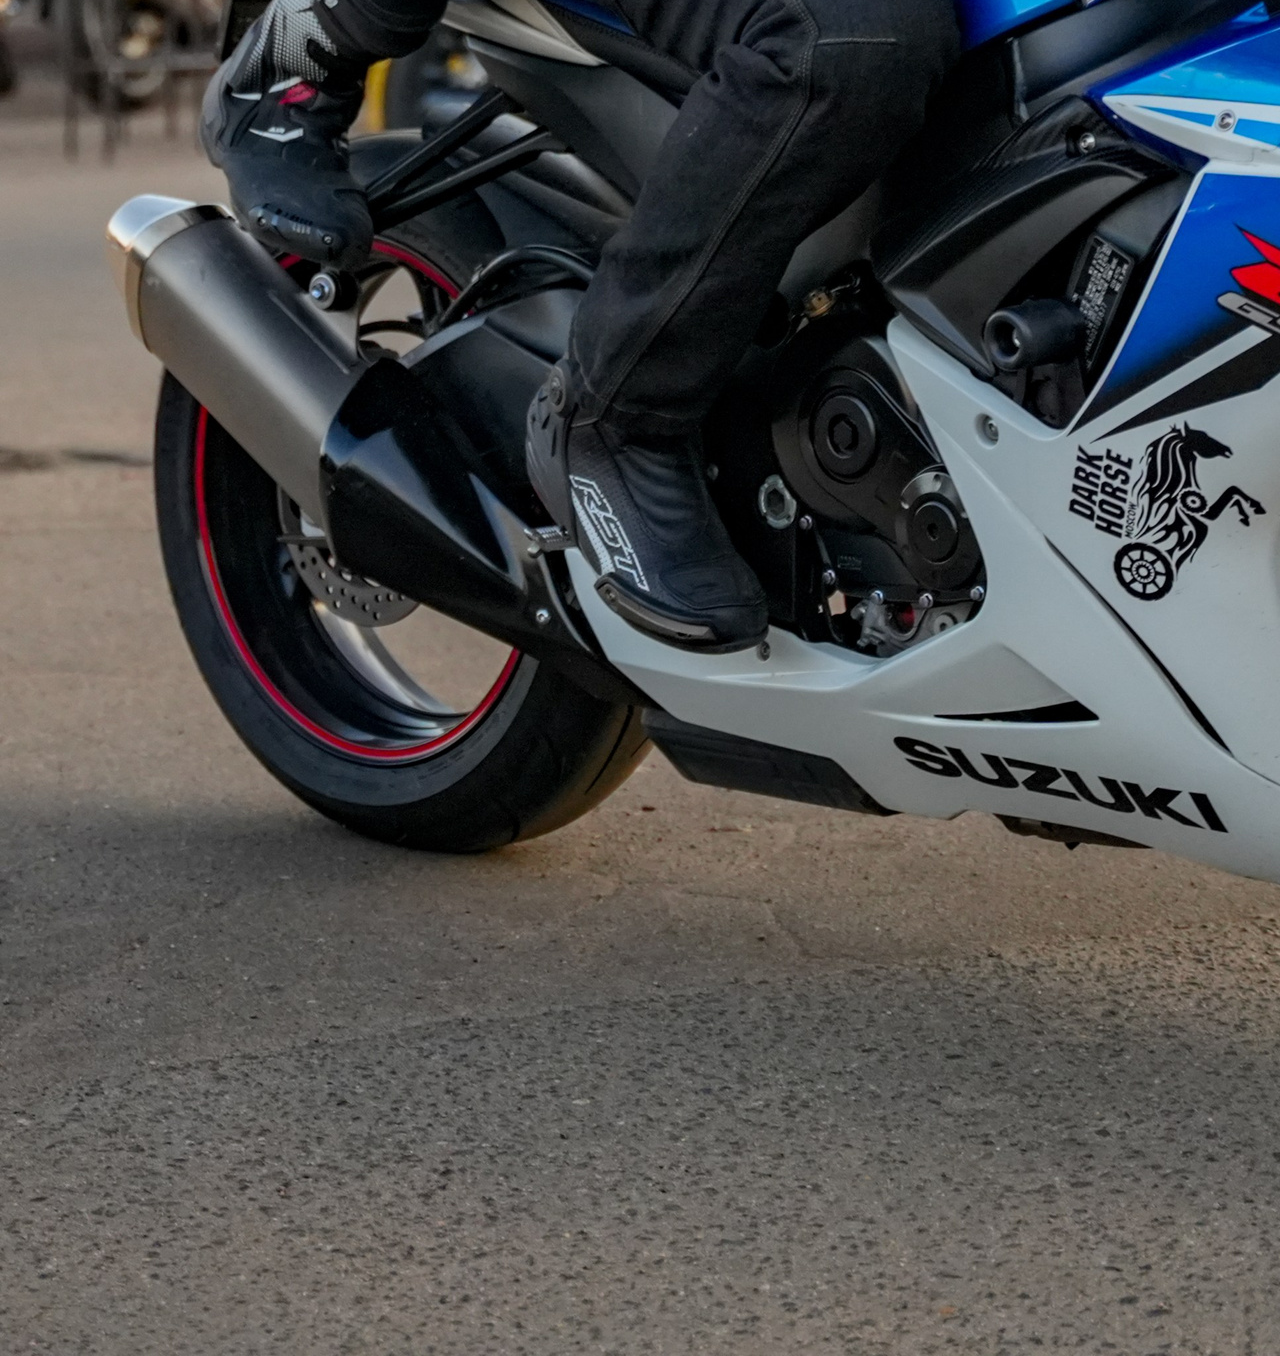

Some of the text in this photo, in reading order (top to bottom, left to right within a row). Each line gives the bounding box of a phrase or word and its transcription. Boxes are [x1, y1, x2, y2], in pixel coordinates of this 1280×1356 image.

[1068, 444, 1104, 522] DARK
[1095, 448, 1133, 539] HORSE
[1124, 501, 1138, 539] MOSCOW
[569, 474, 651, 593] RST
[893, 736, 1229, 833] SUZUKI
